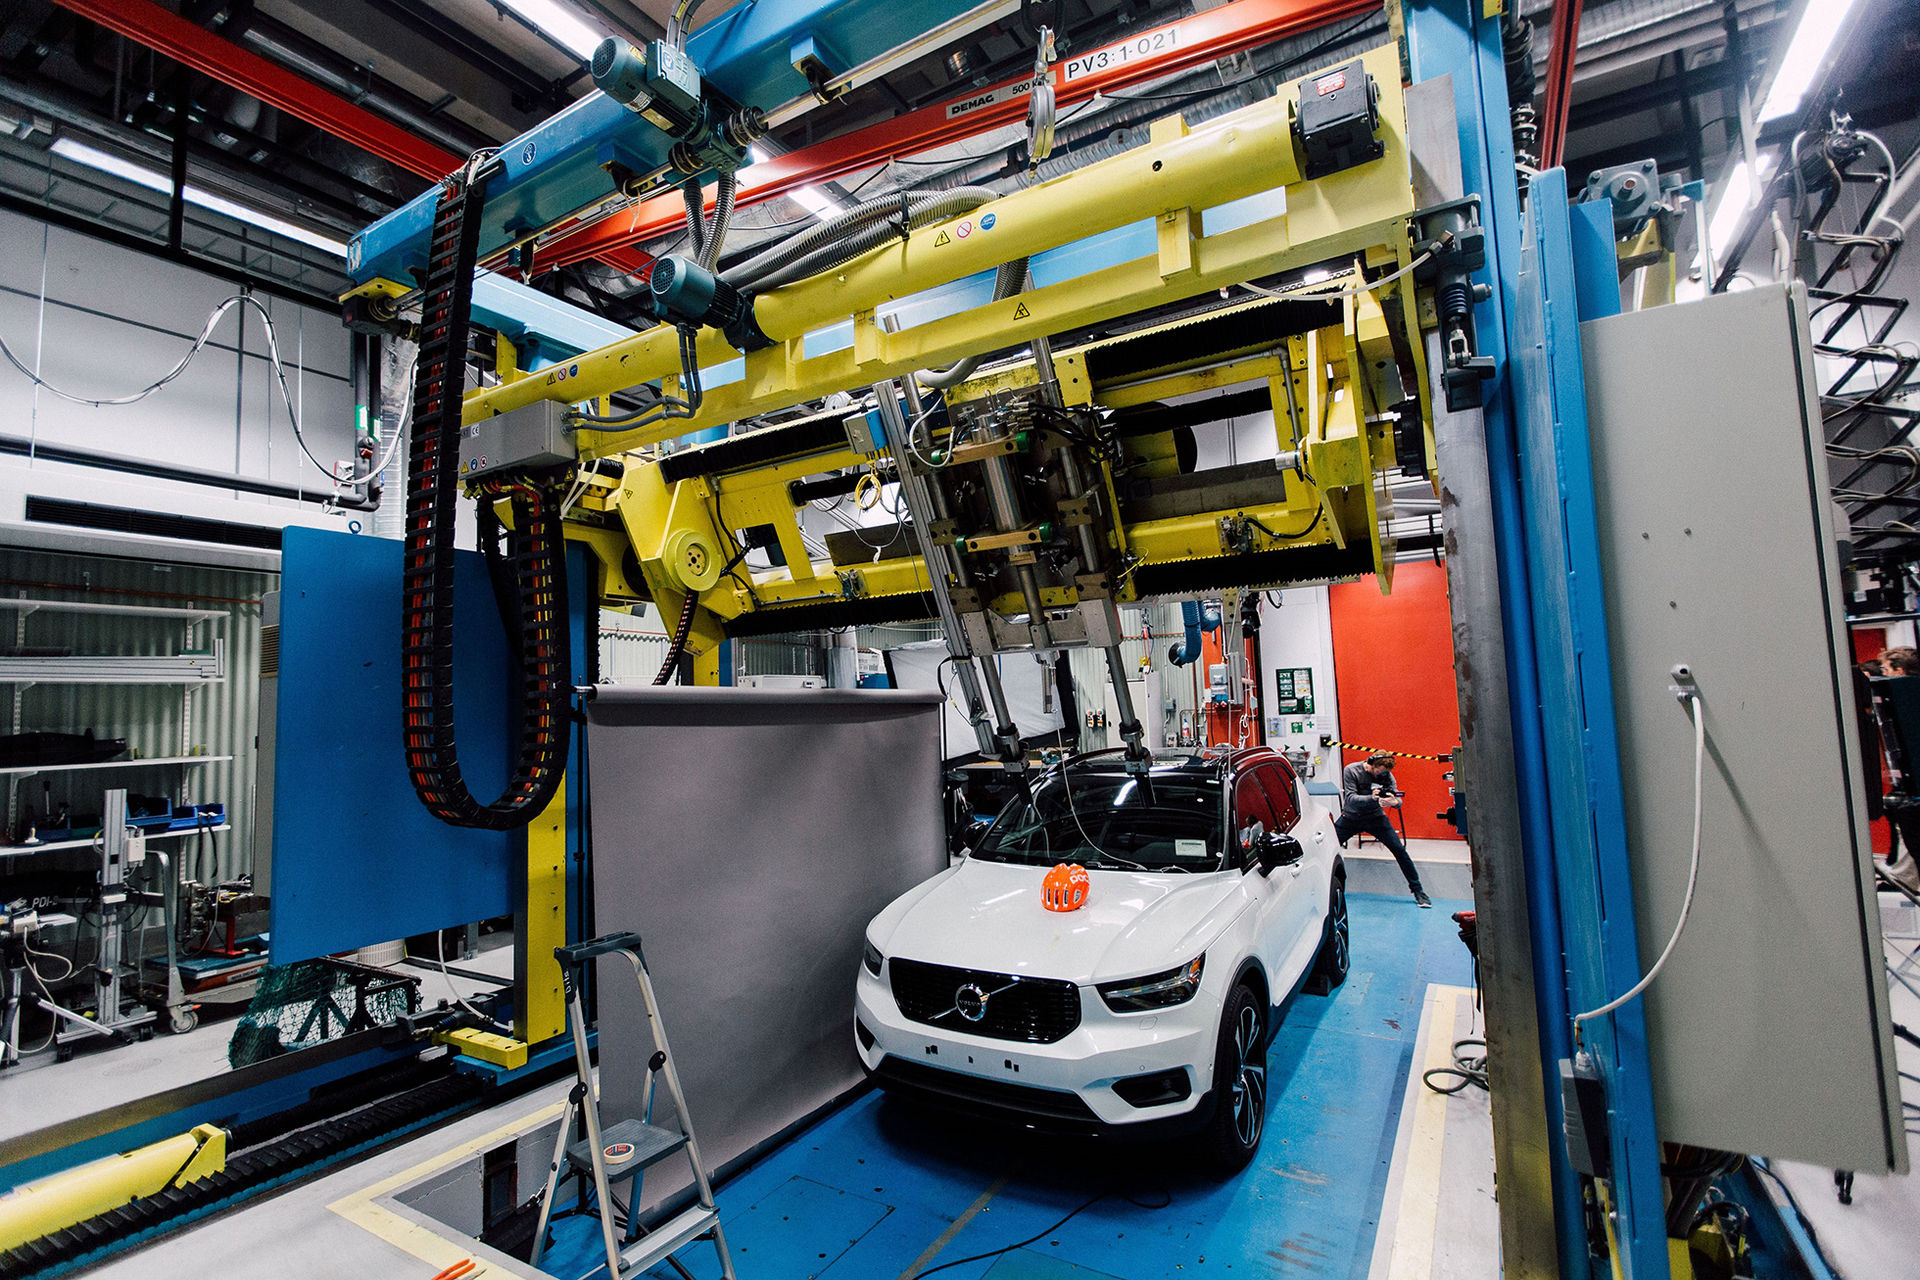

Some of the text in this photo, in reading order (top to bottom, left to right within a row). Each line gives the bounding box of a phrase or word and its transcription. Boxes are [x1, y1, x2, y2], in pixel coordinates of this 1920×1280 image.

[1068, 29, 1177, 79] PV3:1-021
[951, 94, 995, 115] DEMAG
[1012, 82, 1030, 95] 500
